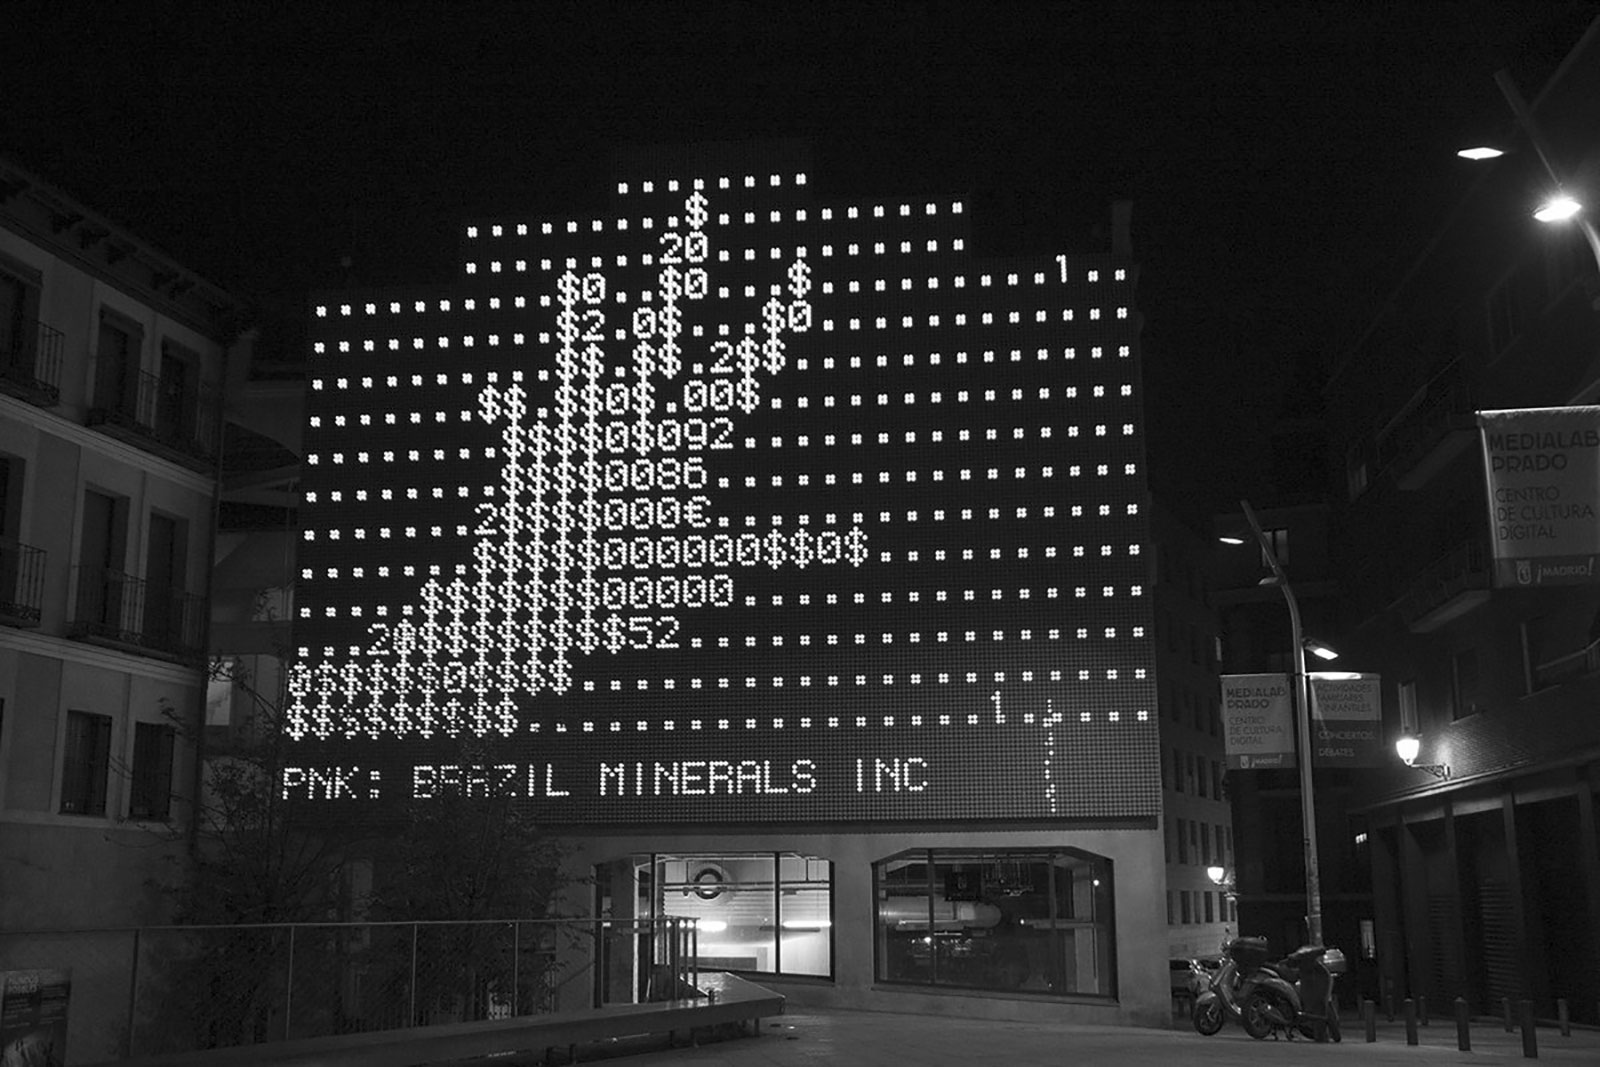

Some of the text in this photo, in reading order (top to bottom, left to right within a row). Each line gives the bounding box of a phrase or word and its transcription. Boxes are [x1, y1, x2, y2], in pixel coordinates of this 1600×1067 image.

[1489, 430, 1600, 451] MEDIALAB
[1491, 453, 1568, 473] PRADO
[1495, 486, 1560, 503] CENTRO
[1497, 504, 1595, 522] DE CULTURA
[1500, 524, 1557, 541] DIGITAL
[1226, 686, 1286, 698] MEDIALAB
[1226, 699, 1270, 710] PRADO
[1229, 716, 1266, 726] CENTRO
[1229, 725, 1283, 736] DE CULTURA
[1230, 736, 1264, 746] DIGITAL
[281, 756, 929, 800] PNK: BRAZIL MINERALS INC
